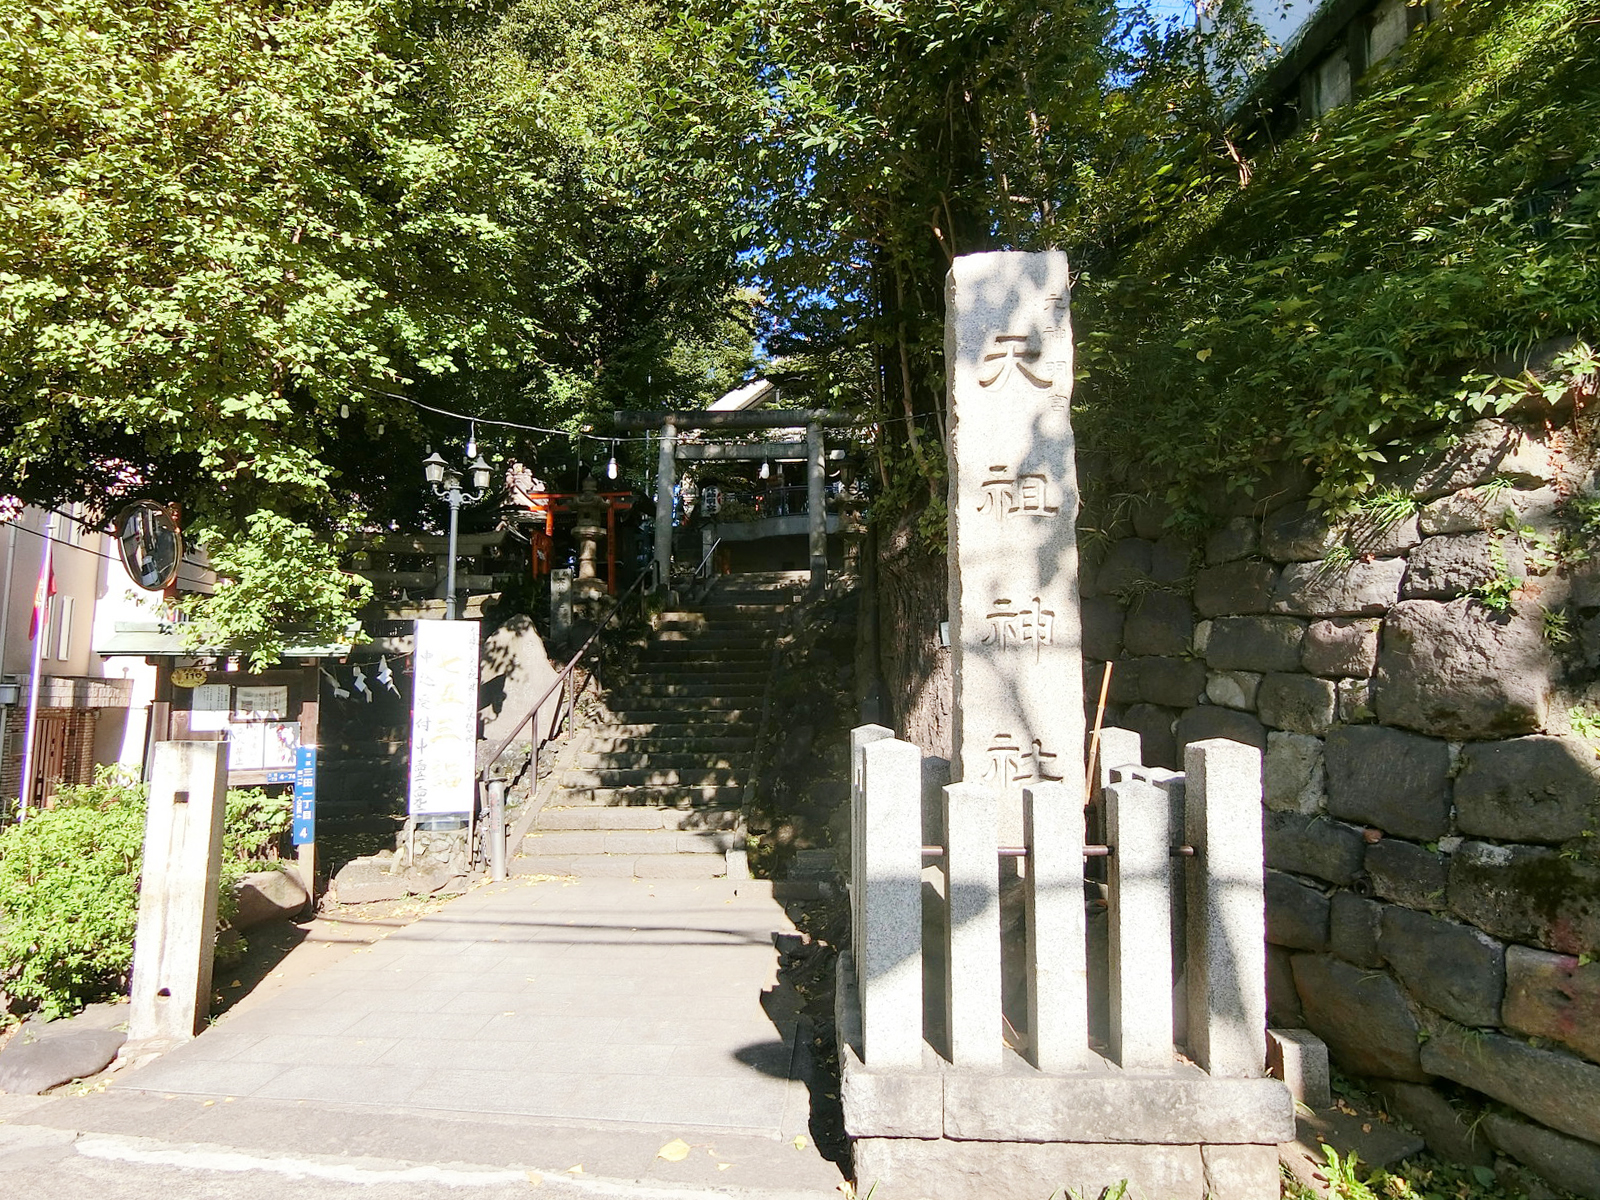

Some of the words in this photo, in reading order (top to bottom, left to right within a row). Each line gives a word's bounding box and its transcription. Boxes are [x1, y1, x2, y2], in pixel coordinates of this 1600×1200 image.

[1042, 293, 1068, 412] 元神明宮
[978, 334, 1064, 789] 天祖神社
[299, 827, 308, 839] 4
[302, 767, 314, 820] 三田一丁目
